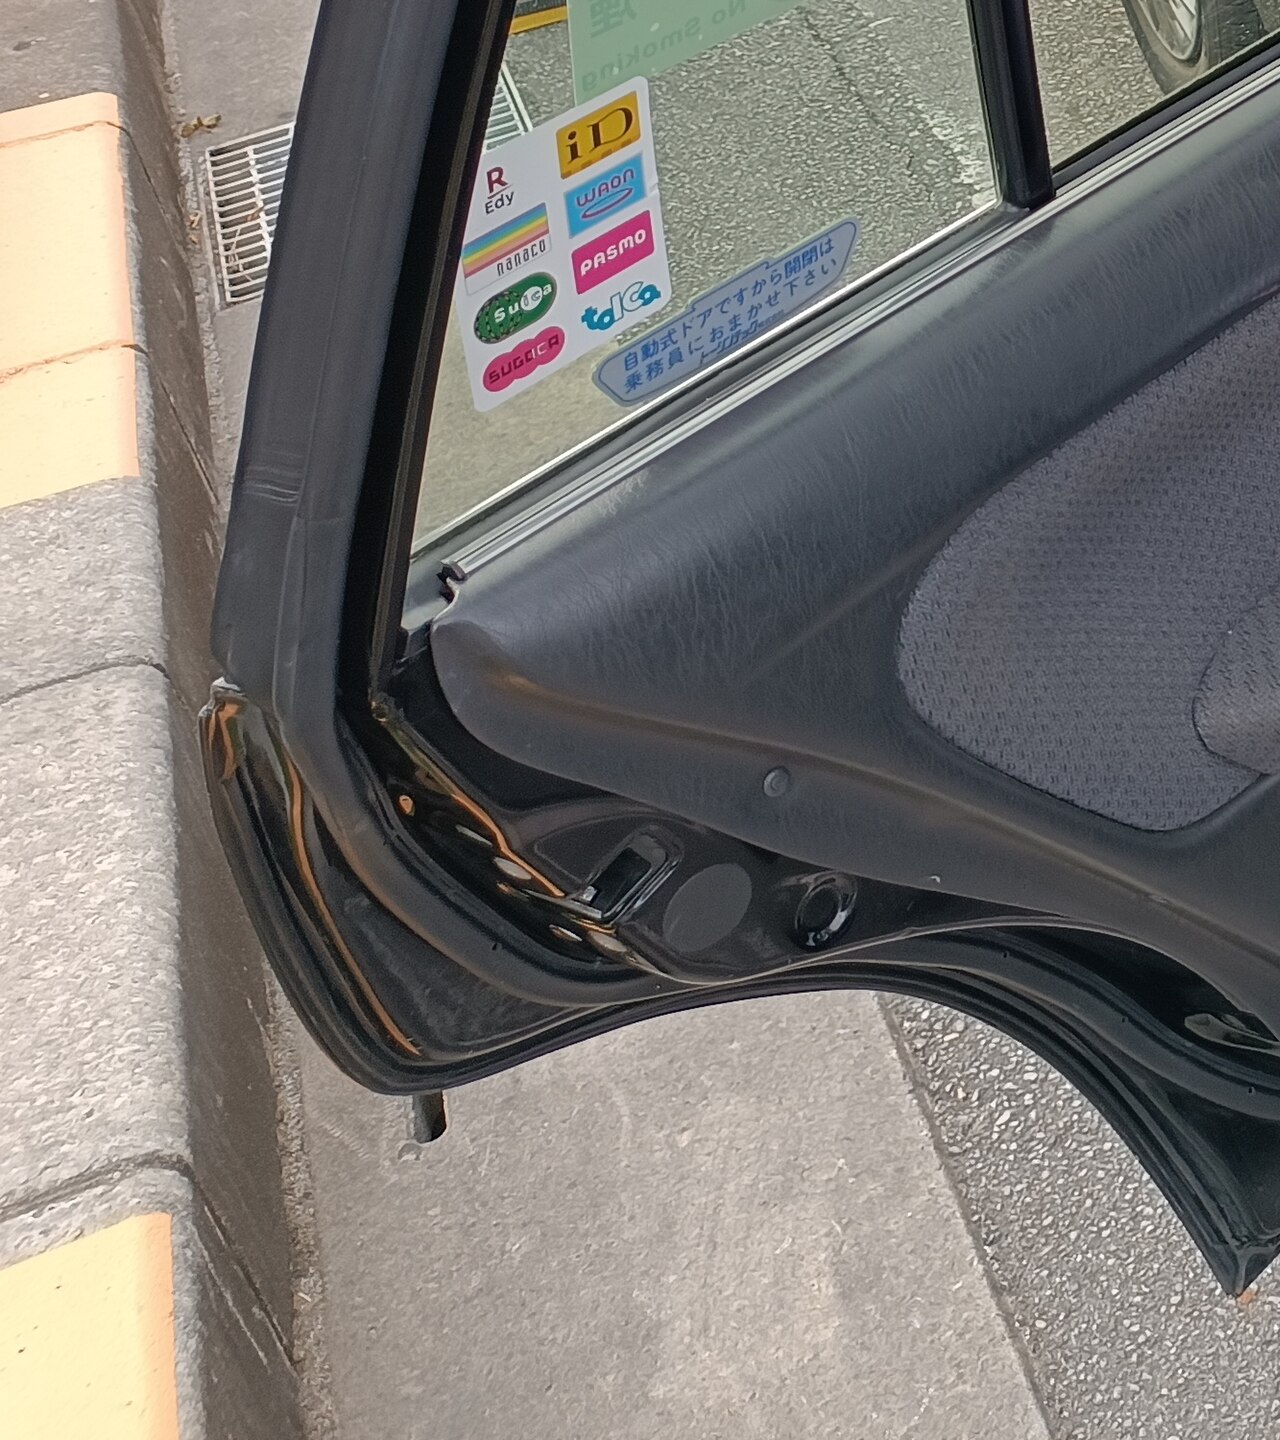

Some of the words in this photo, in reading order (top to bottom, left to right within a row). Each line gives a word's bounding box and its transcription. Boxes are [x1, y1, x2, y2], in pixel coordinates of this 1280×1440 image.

[566, 106, 635, 164] iD
[485, 190, 515, 215] Edy
[496, 239, 548, 277] nanaco
[488, 333, 560, 384] SUGOCA
